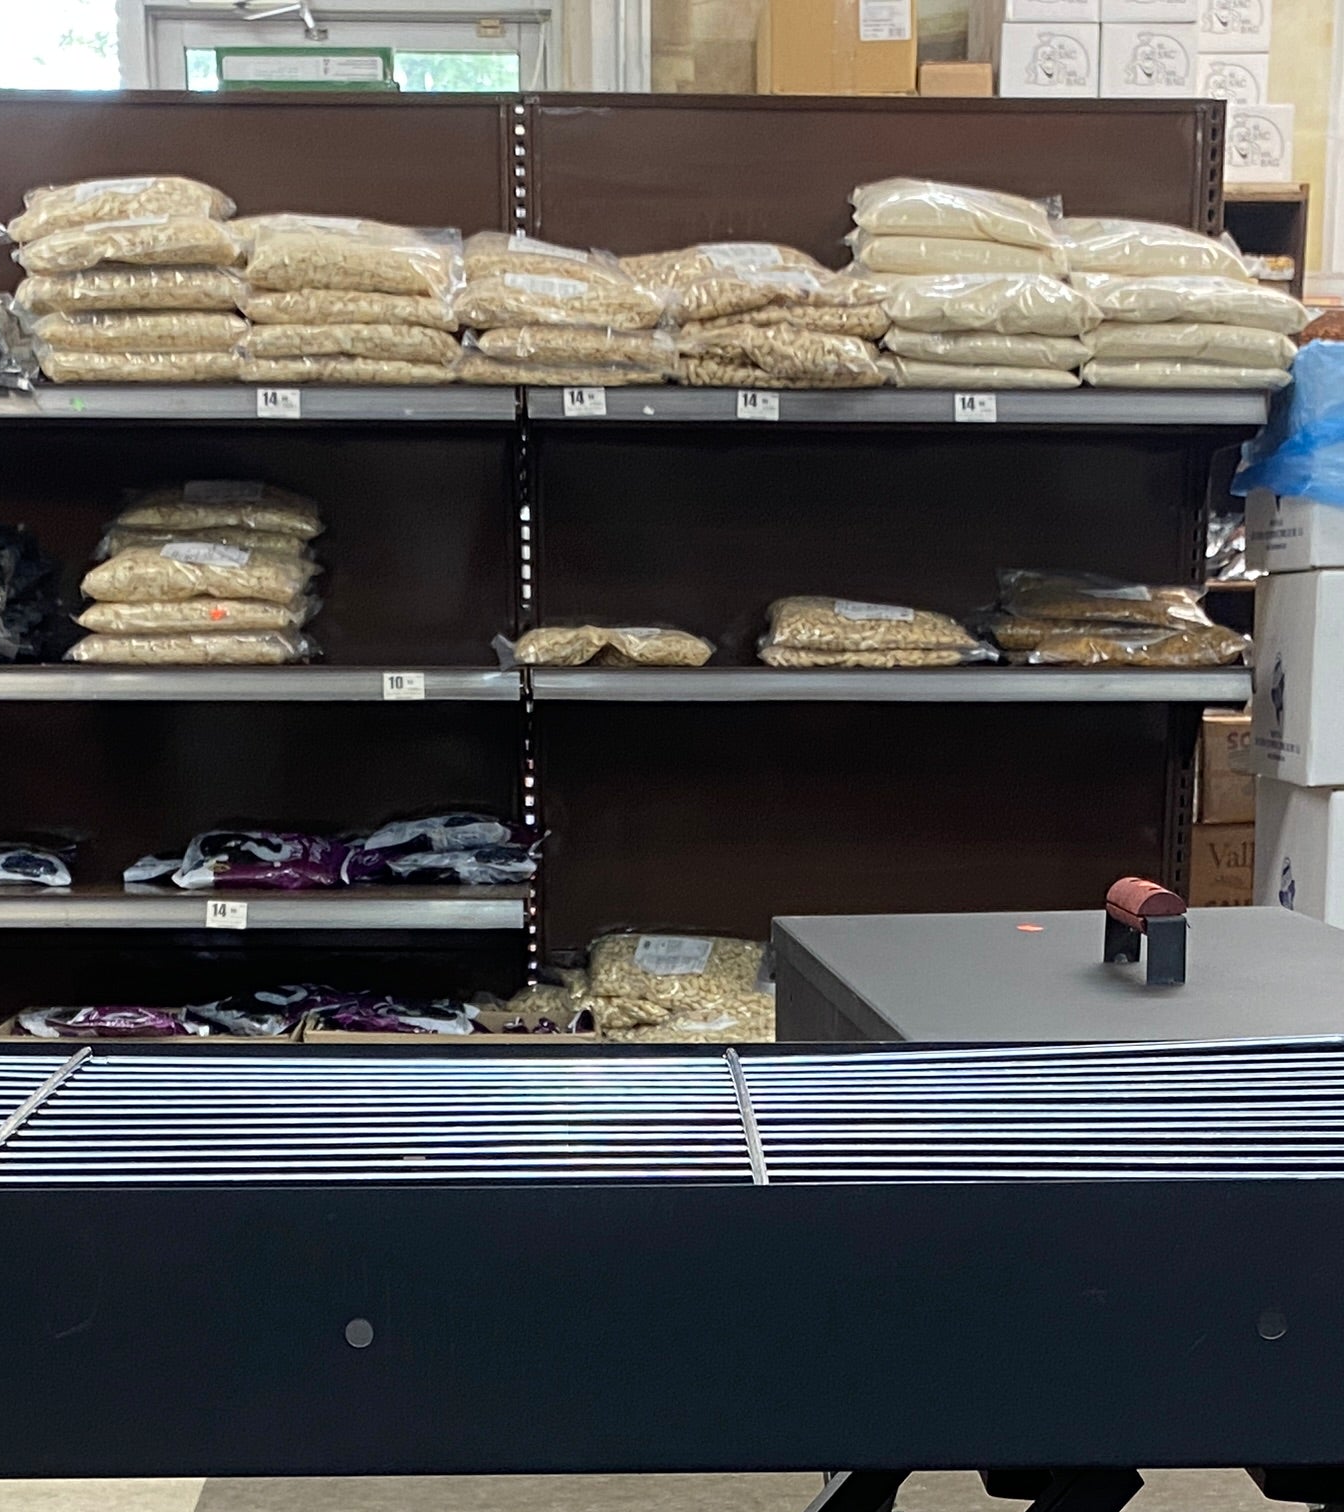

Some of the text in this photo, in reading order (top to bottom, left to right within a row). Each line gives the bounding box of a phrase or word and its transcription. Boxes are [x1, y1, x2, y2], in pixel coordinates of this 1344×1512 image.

[263, 391, 277, 406] 14
[569, 390, 584, 405] 14
[743, 393, 757, 407] 14
[961, 397, 975, 410] 14
[389, 676, 403, 689] 10
[213, 903, 226, 917] 14
